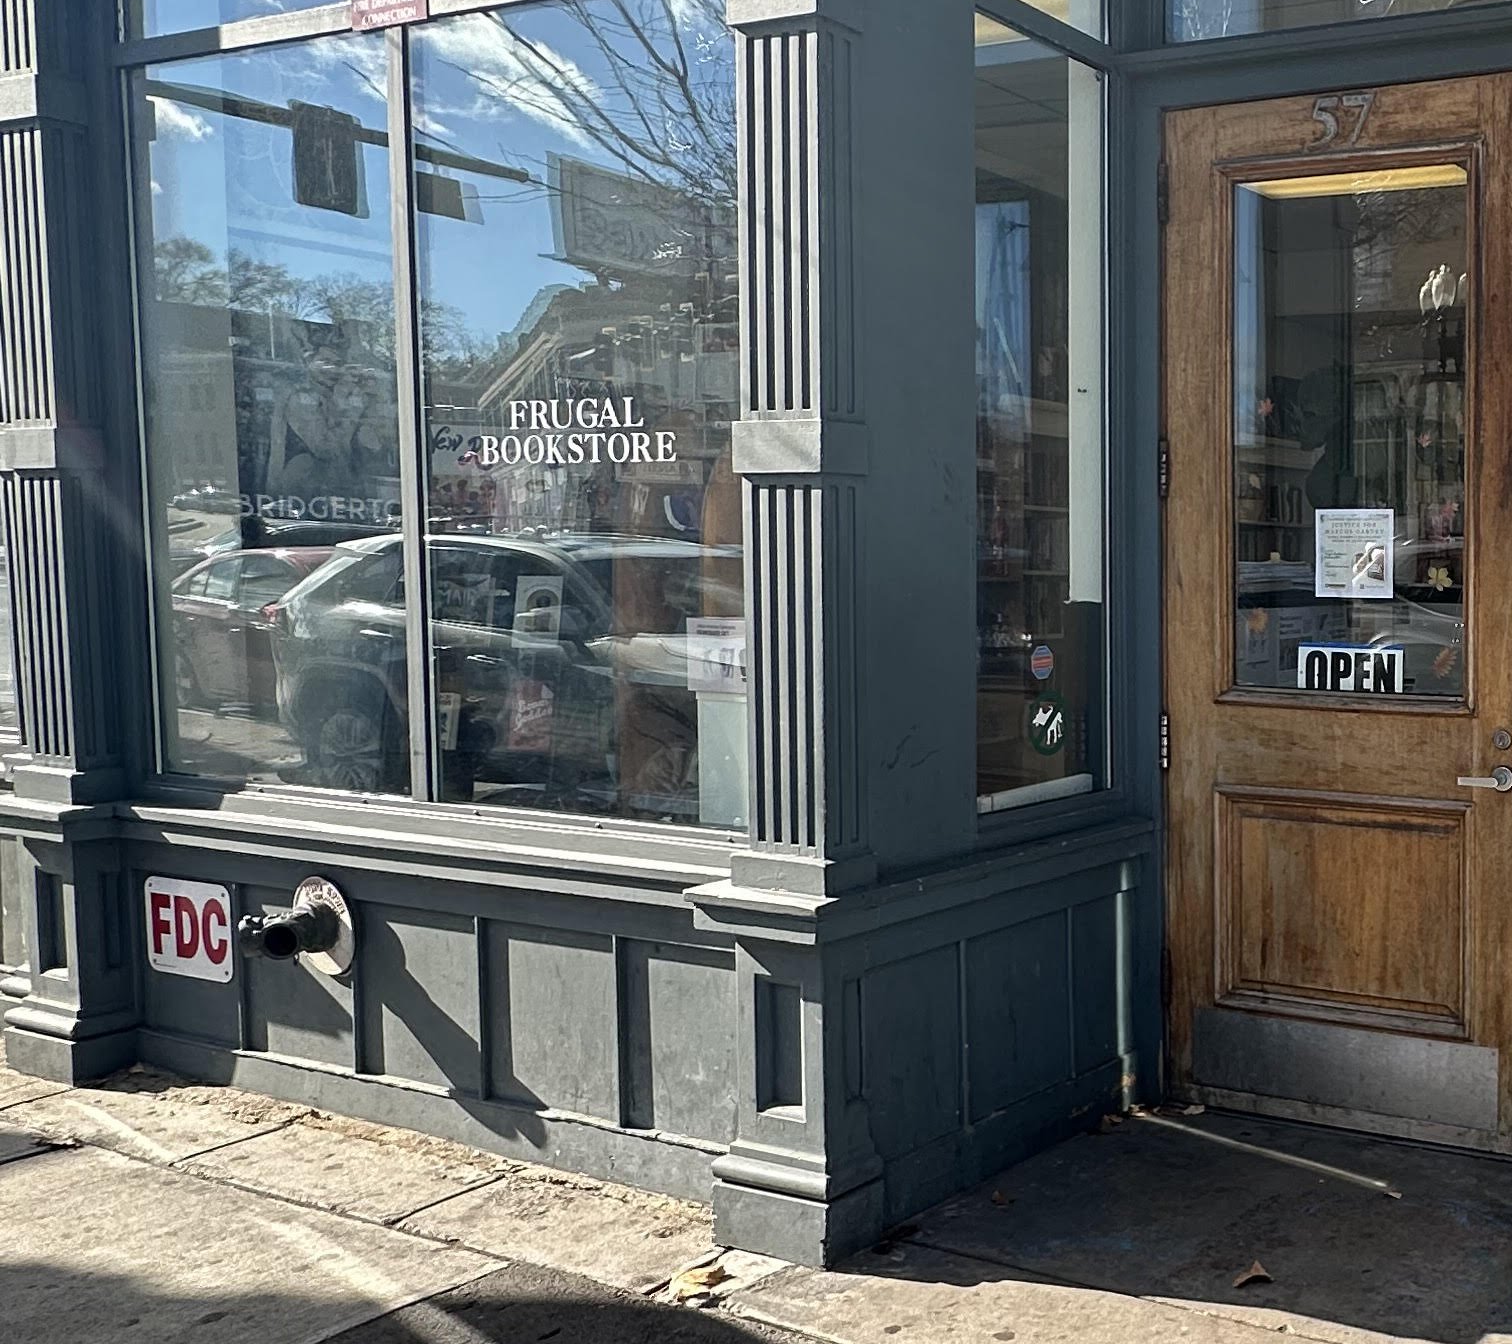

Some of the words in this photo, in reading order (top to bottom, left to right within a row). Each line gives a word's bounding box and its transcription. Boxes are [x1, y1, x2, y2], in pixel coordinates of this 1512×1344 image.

[1304, 92, 1376, 152] 57
[508, 396, 644, 431] FRUGAL
[480, 430, 678, 465] BOOKSTORE
[1306, 650, 1396, 693] OPEN
[151, 892, 228, 965] FDC
